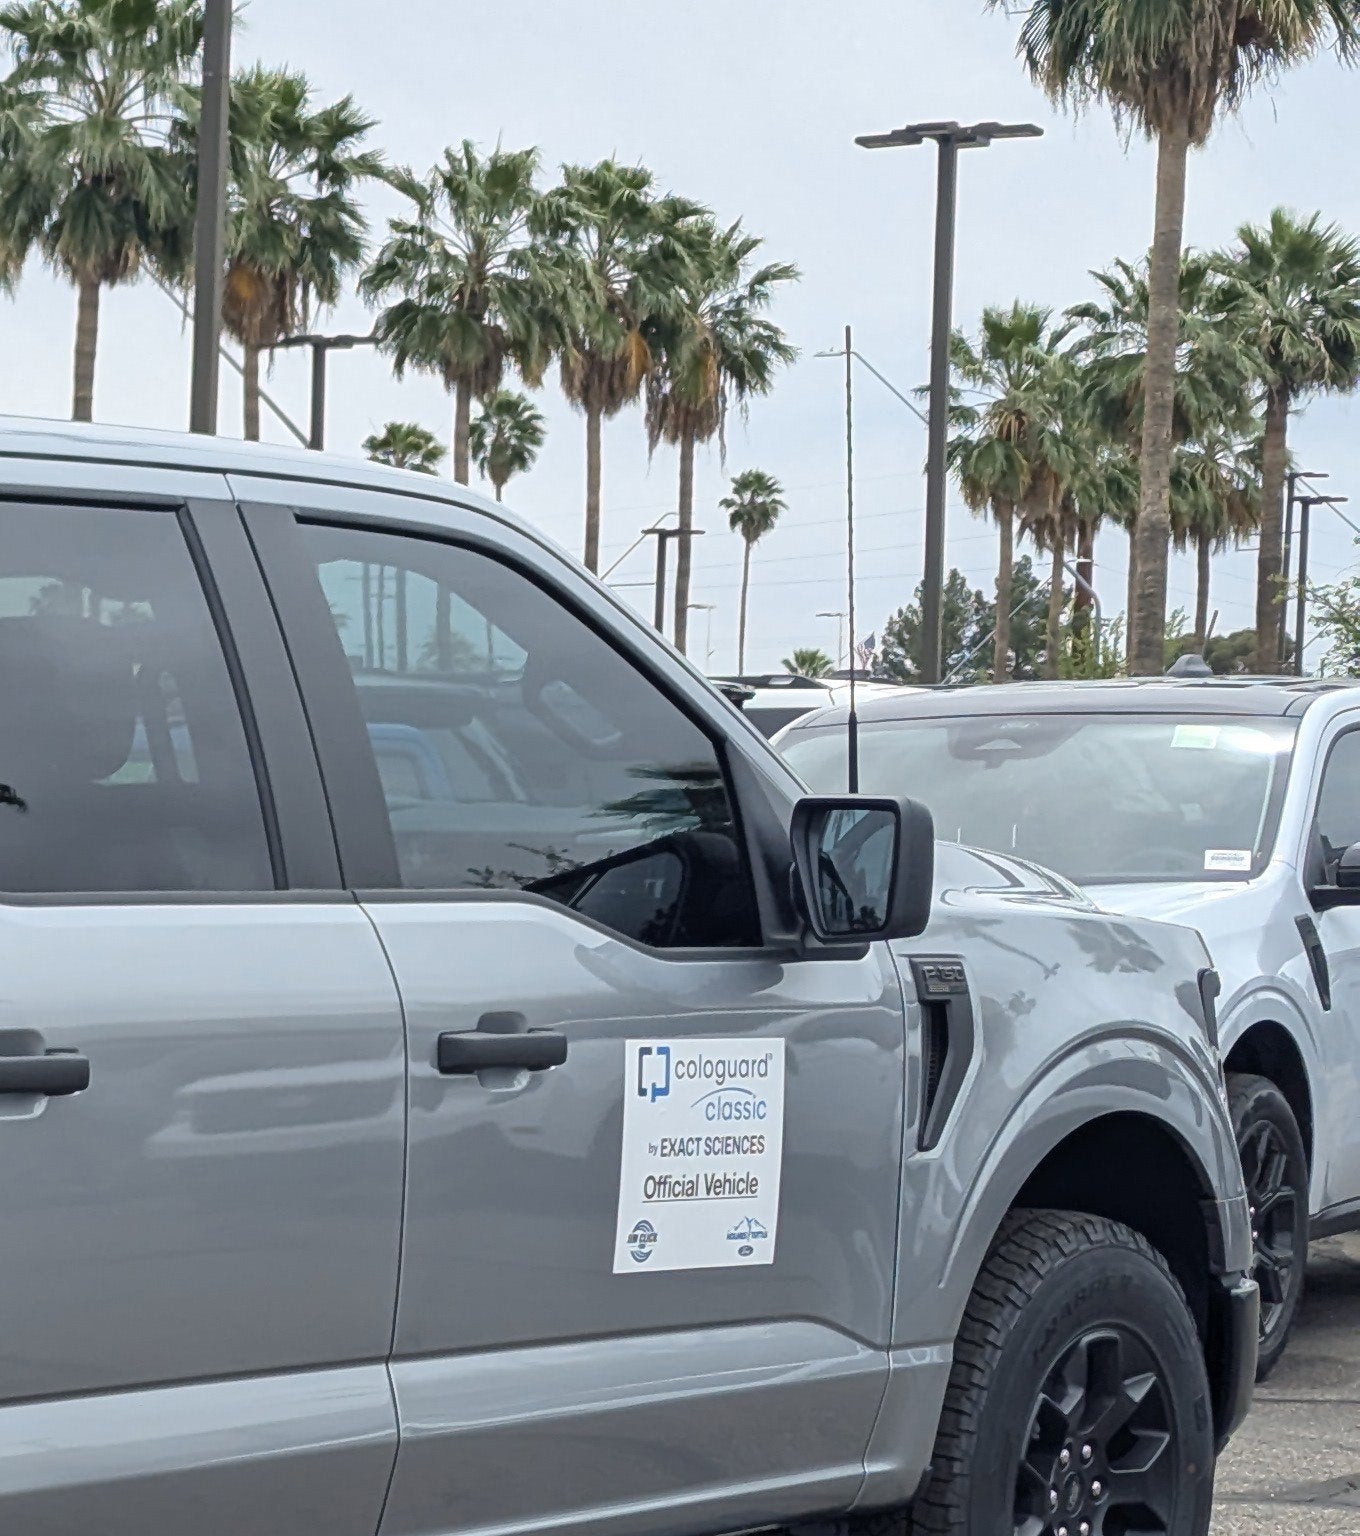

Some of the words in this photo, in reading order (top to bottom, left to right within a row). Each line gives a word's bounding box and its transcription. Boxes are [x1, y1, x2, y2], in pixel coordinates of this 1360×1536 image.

[705, 1095, 768, 1121] classic
[648, 1142, 658, 1156] by
[660, 1136, 702, 1158] EXACT
[703, 1134, 766, 1156] SCIENCES
[643, 1174, 700, 1200] Official
[704, 1171, 759, 1196] Vehicle
